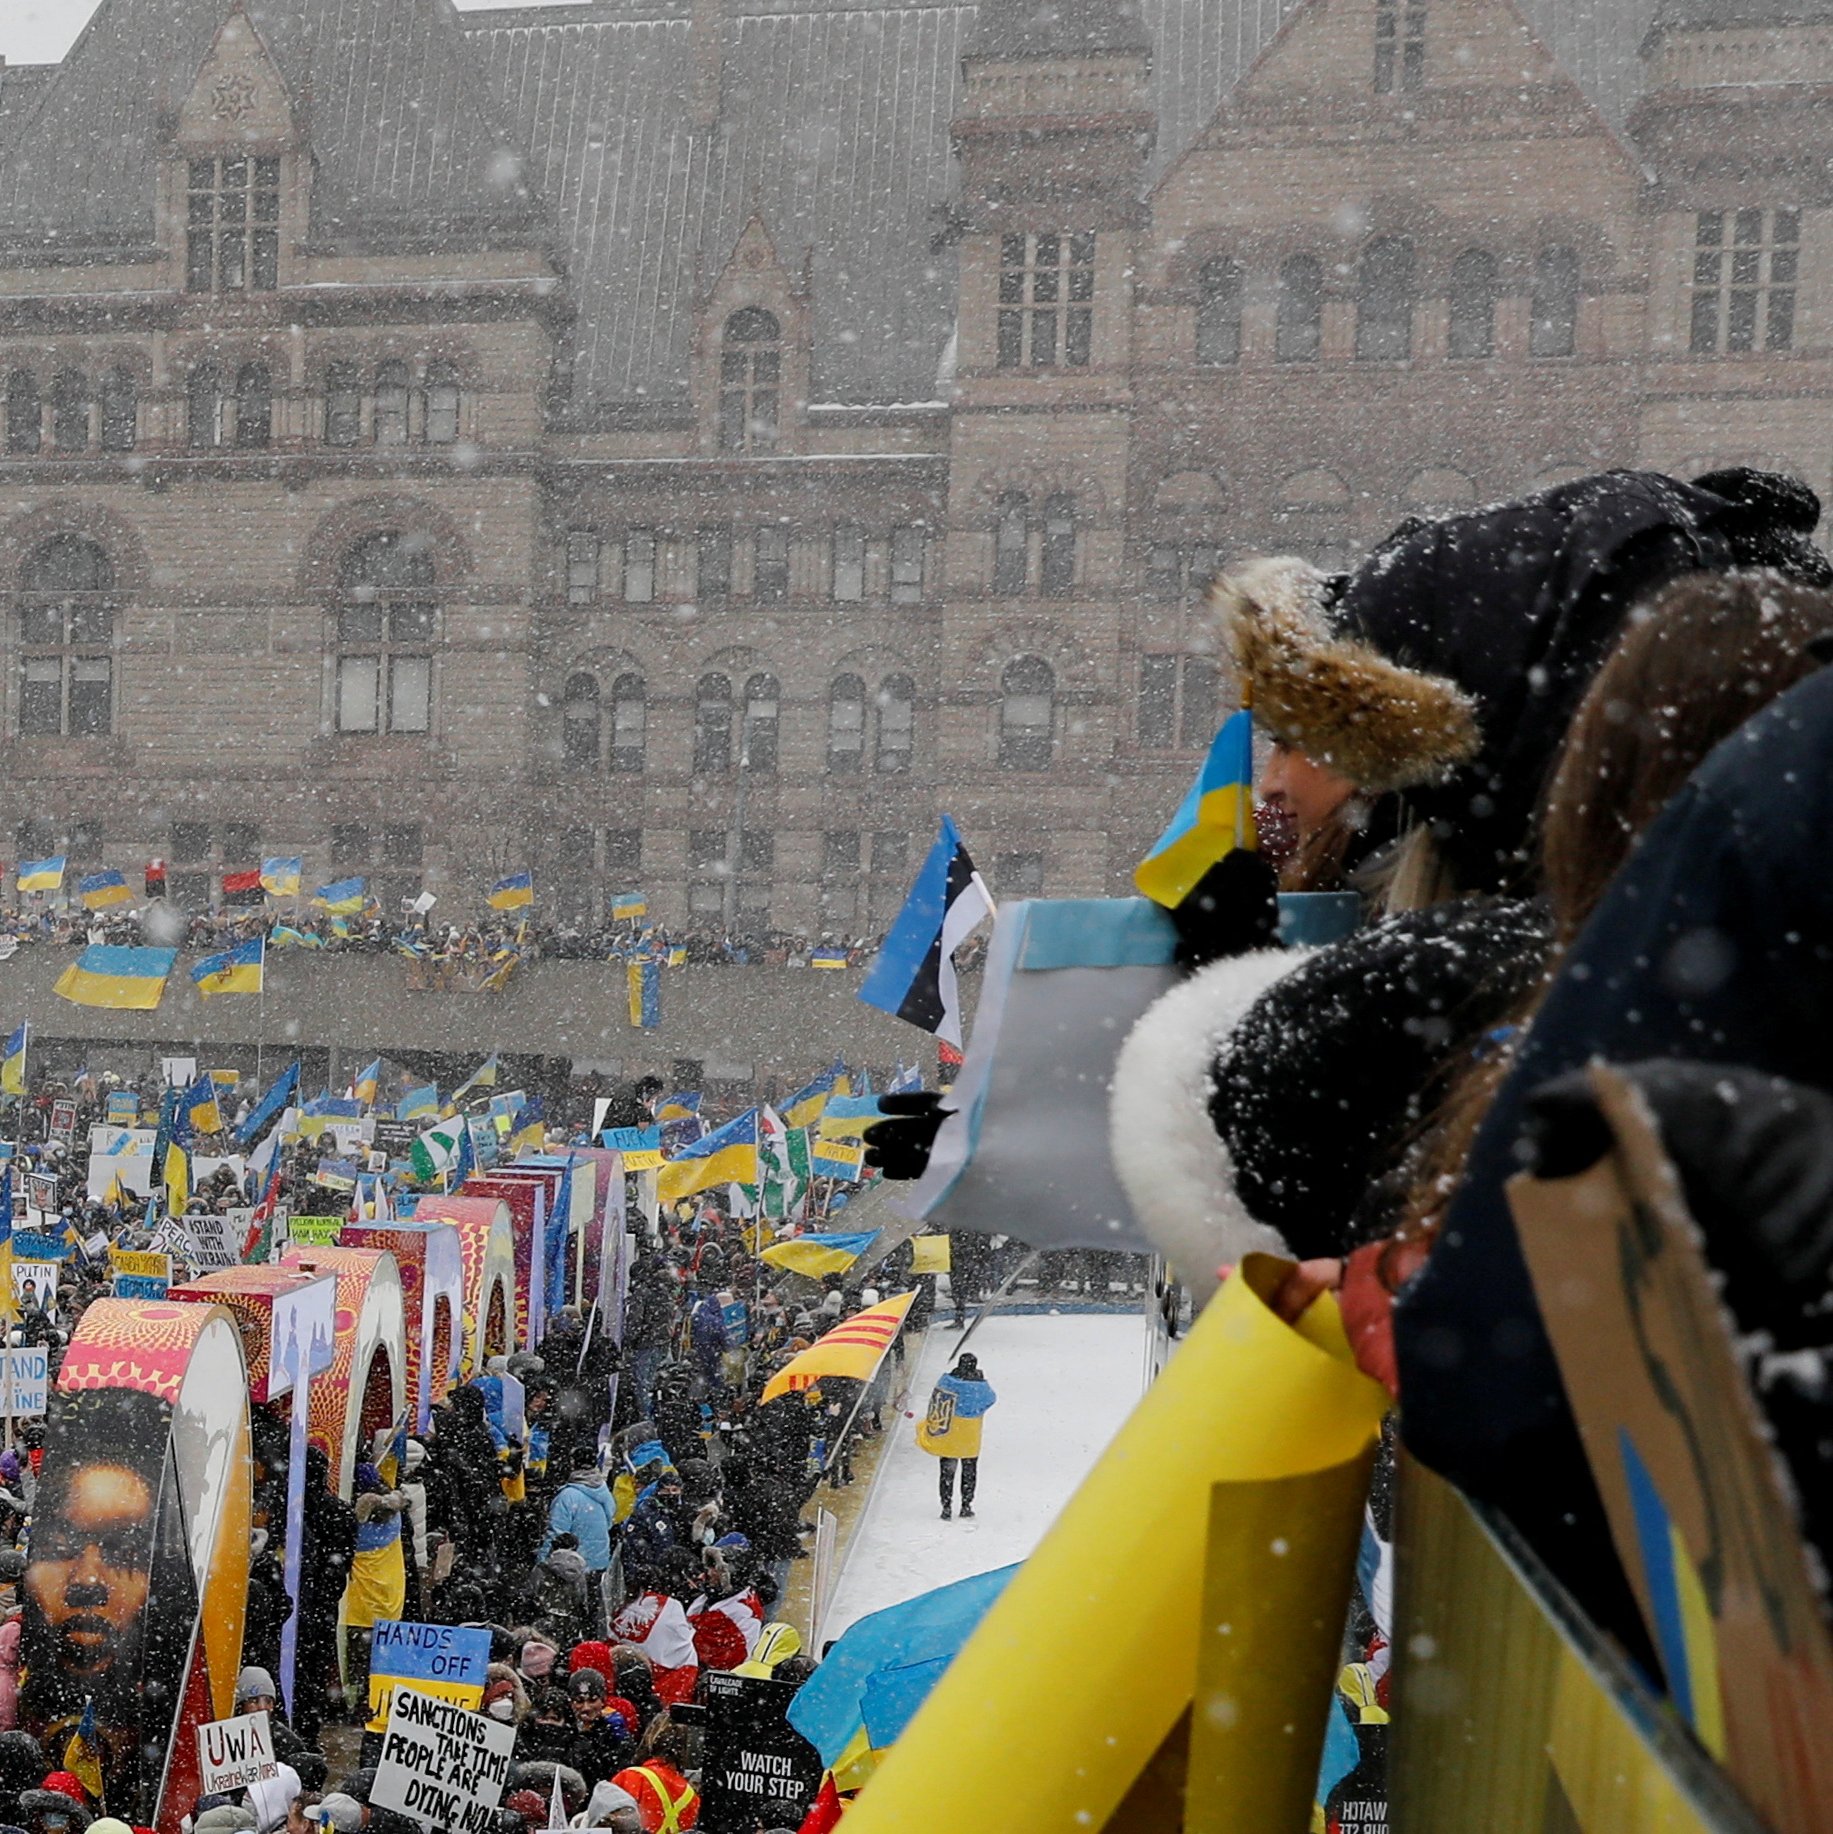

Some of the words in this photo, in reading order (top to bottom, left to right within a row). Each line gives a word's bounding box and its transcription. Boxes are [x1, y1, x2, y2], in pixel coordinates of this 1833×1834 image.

[613, 1130, 647, 1148] FUCK
[826, 1145, 856, 1161] NATO
[31, 1179, 52, 1192] STOP
[162, 1220, 193, 1257] PEAC
[197, 1236, 224, 1250] WITH
[195, 1252, 237, 1266] UKRAINE
[16, 1265, 52, 1278] PUTIN
[376, 1624, 453, 1650] HANDS
[431, 1654, 471, 1678] OFF
[718, 1686, 739, 1697] LIGHTS
[395, 1690, 488, 1744] SANCTIONS
[384, 1735, 446, 1780] PEOPLE
[446, 1766, 480, 1796] ARE
[471, 1744, 507, 1785] TIME
[740, 1751, 793, 1776] WATCH
[726, 1770, 765, 1792] YOUR
[768, 1776, 804, 1800] STEP
[403, 1779, 455, 1828] DYING
